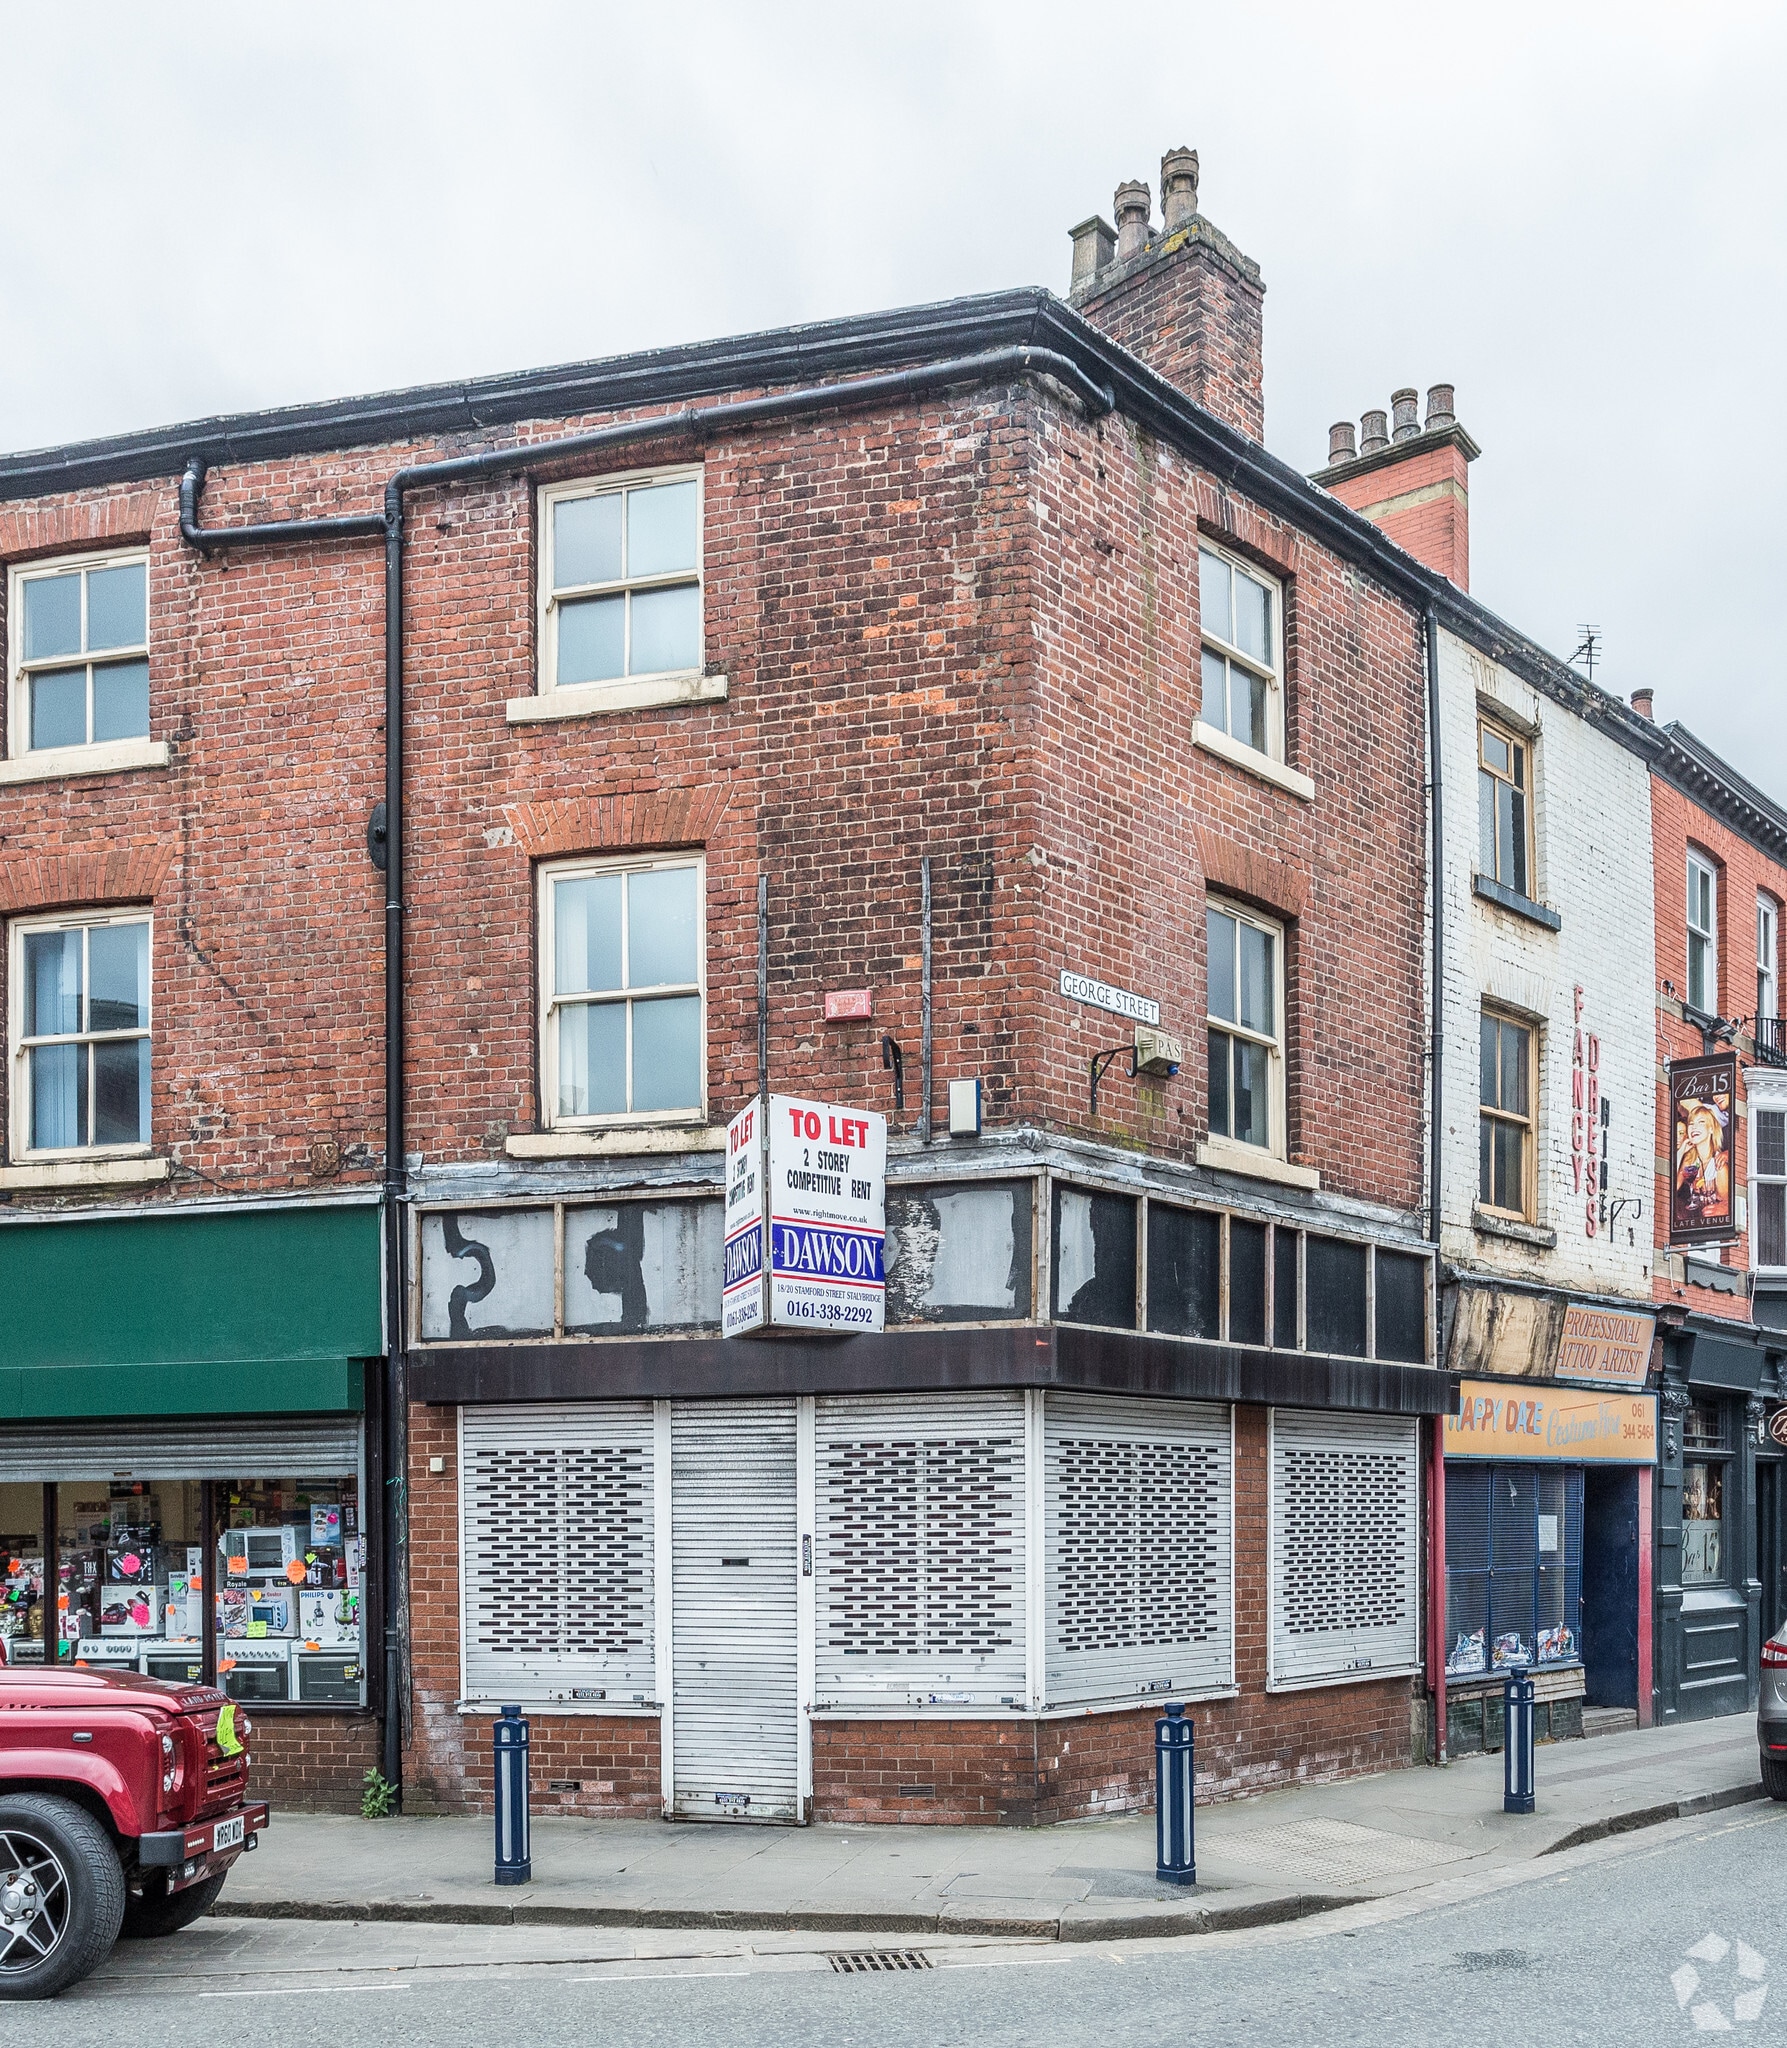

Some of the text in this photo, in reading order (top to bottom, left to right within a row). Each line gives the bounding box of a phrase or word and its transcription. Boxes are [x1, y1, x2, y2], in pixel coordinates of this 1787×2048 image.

[1063, 975, 1157, 1020] GEORGE STREET
[1572, 984, 1585, 1194] FANCY
[1675, 1072, 1729, 1099] Bar 15
[730, 1110, 754, 1156] TO LET
[788, 1108, 869, 1148] TO LET
[1585, 1032, 1599, 1238] DRESS
[803, 1148, 850, 1174] 2 STOREY
[787, 1169, 871, 1201] COMPETITIVE RENT
[793, 1206, 868, 1225] www.rightmove.co.uk
[1674, 1216, 1731, 1228] LATE VENUE
[726, 1229, 760, 1284] DAWSON
[781, 1228, 877, 1278] DAWSON
[777, 1284, 882, 1303] 18/20 STAMFORD STREET STALYBRIDGE
[787, 1300, 873, 1323] 0161-338-2292
[1562, 1311, 1642, 1346] PROFESSIONAL
[1598, 1347, 1644, 1374] ARTIST
[1506, 1399, 1544, 1435] DAZE
[1632, 1403, 1645, 1418] 061
[1623, 1423, 1654, 1440] 344 5464
[226, 1580, 248, 1589] Royale
[300, 1591, 325, 1599] PHILIPS
